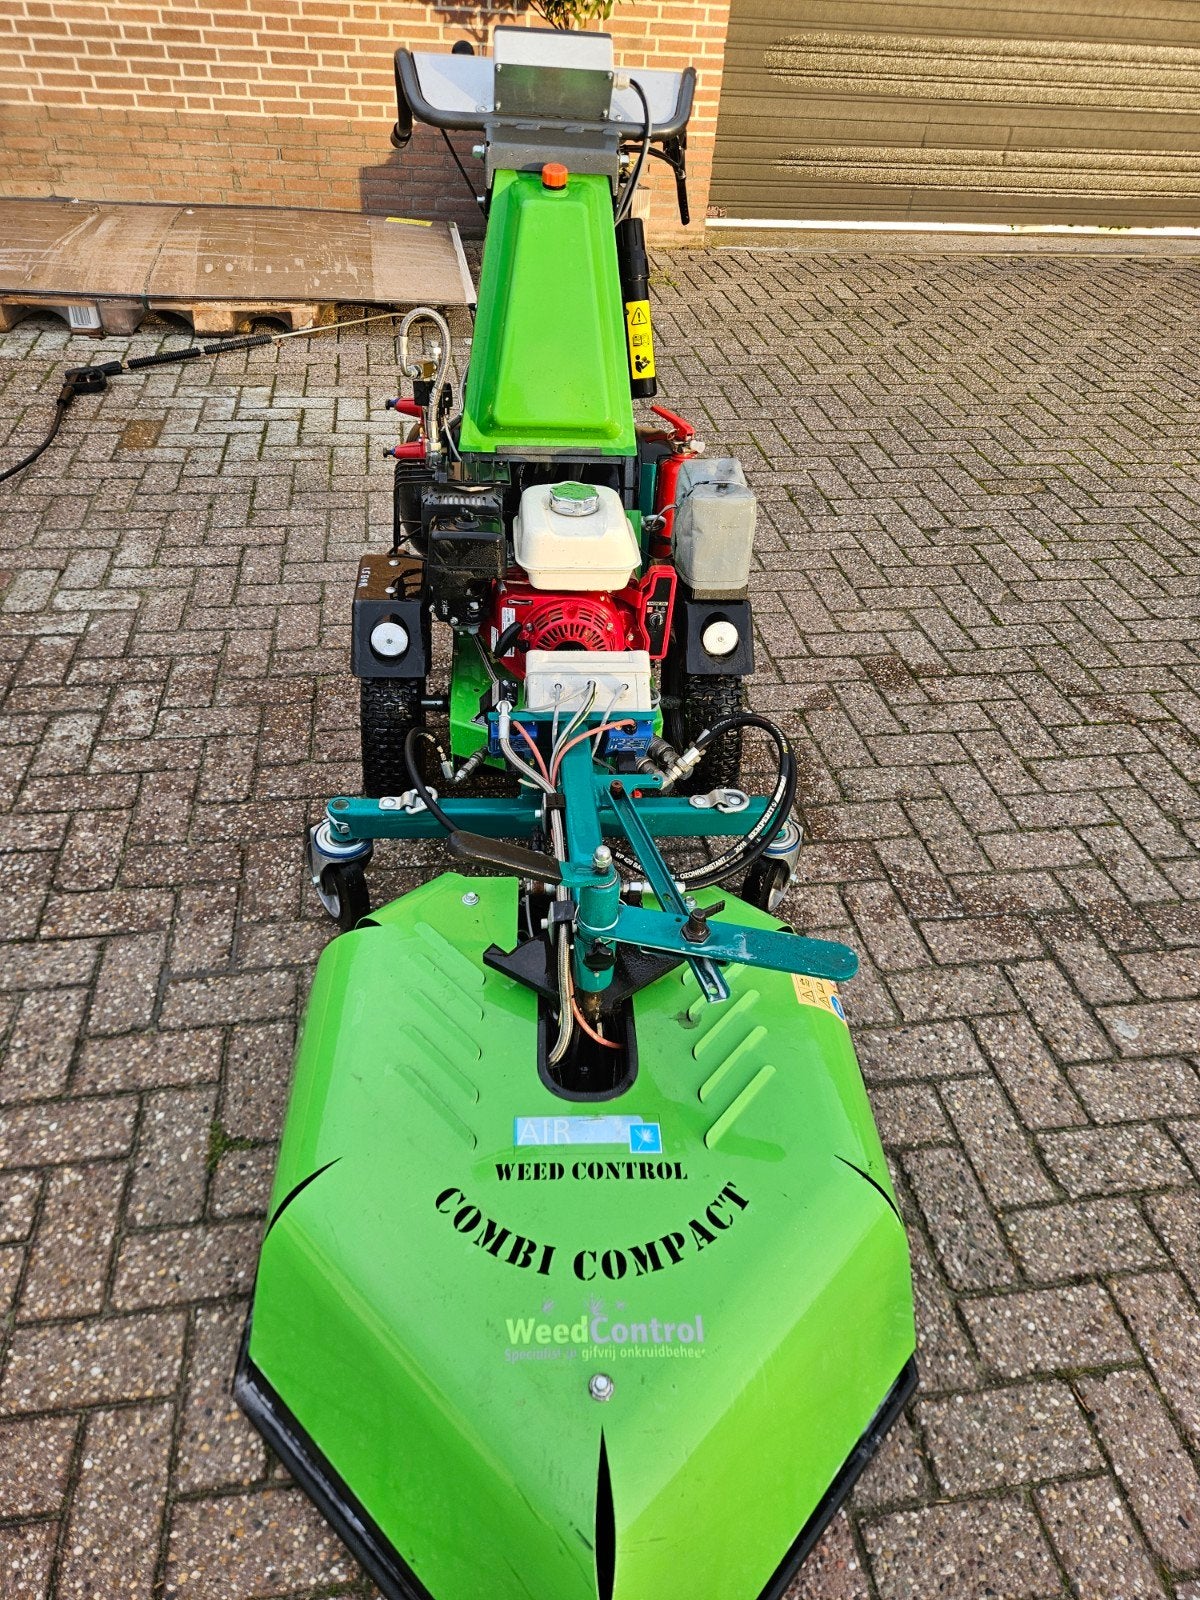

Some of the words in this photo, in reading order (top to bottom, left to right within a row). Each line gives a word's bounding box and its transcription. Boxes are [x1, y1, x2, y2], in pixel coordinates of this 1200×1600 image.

[679, 856, 726, 879] OZONRESISTANT
[517, 1119, 571, 1145] AIR
[495, 1162, 565, 1181] WEED
[571, 1161, 689, 1180] CONTROL
[435, 1187, 557, 1276] COMBI
[573, 1181, 749, 1281] COMPACT
[505, 1315, 704, 1345] WeedControl
[581, 1345, 616, 1361] gifvrij
